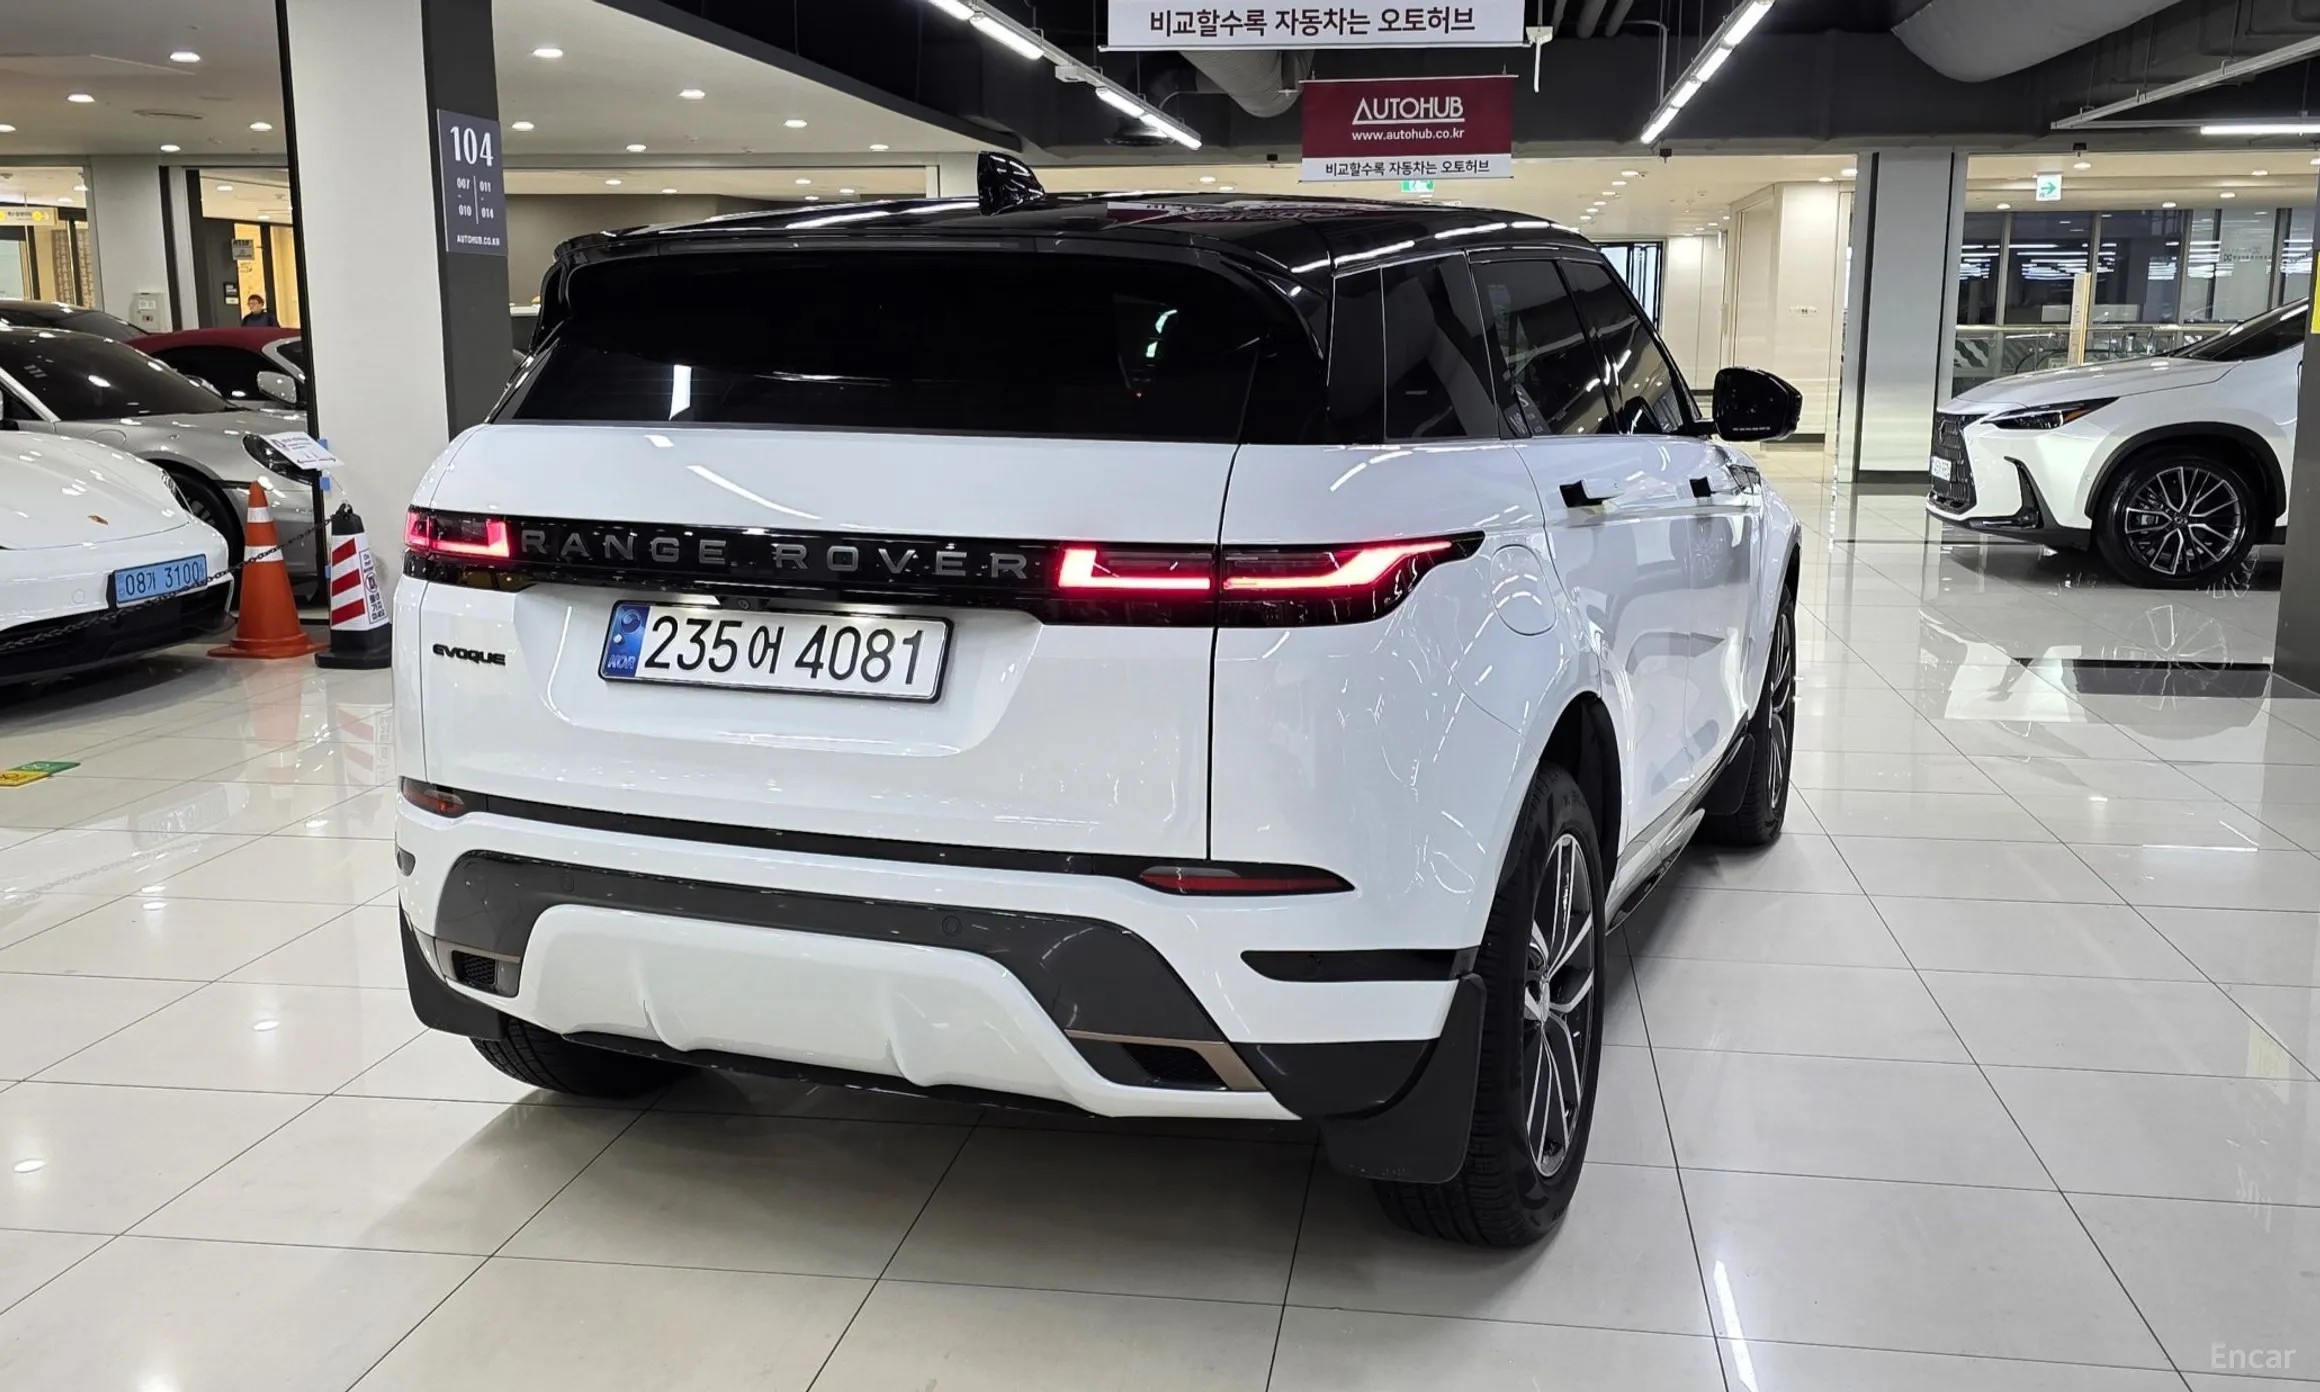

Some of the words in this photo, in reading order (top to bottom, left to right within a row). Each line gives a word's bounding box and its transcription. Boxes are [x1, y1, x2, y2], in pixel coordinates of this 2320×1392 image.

[1150, 9, 1268, 37] 비교할수록
[1275, 8, 1371, 36] 자동차는
[1378, 6, 1476, 34] 오토허브
[1352, 96, 1465, 125] AUTOHUB
[1352, 128, 1466, 141] www.autohub.co.kr
[450, 126, 494, 167] 104
[1325, 162, 1385, 177] 비교할수록
[1389, 161, 1437, 176] 자동차는
[1440, 159, 1490, 174] 오토허브
[456, 177, 470, 190] 007
[479, 181, 491, 192] 011
[458, 205, 472, 217] 010
[456, 234, 500, 247] AUTOHUB.CO.KR
[521, 529, 727, 565] RANGE
[774, 543, 1027, 580] ROVER
[125, 571, 156, 596] 08가
[164, 561, 200, 588] 3100
[432, 643, 506, 666] EVOQUE
[644, 615, 784, 674] 235어
[795, 624, 923, 685] 4081
[607, 654, 636, 669] KOR
